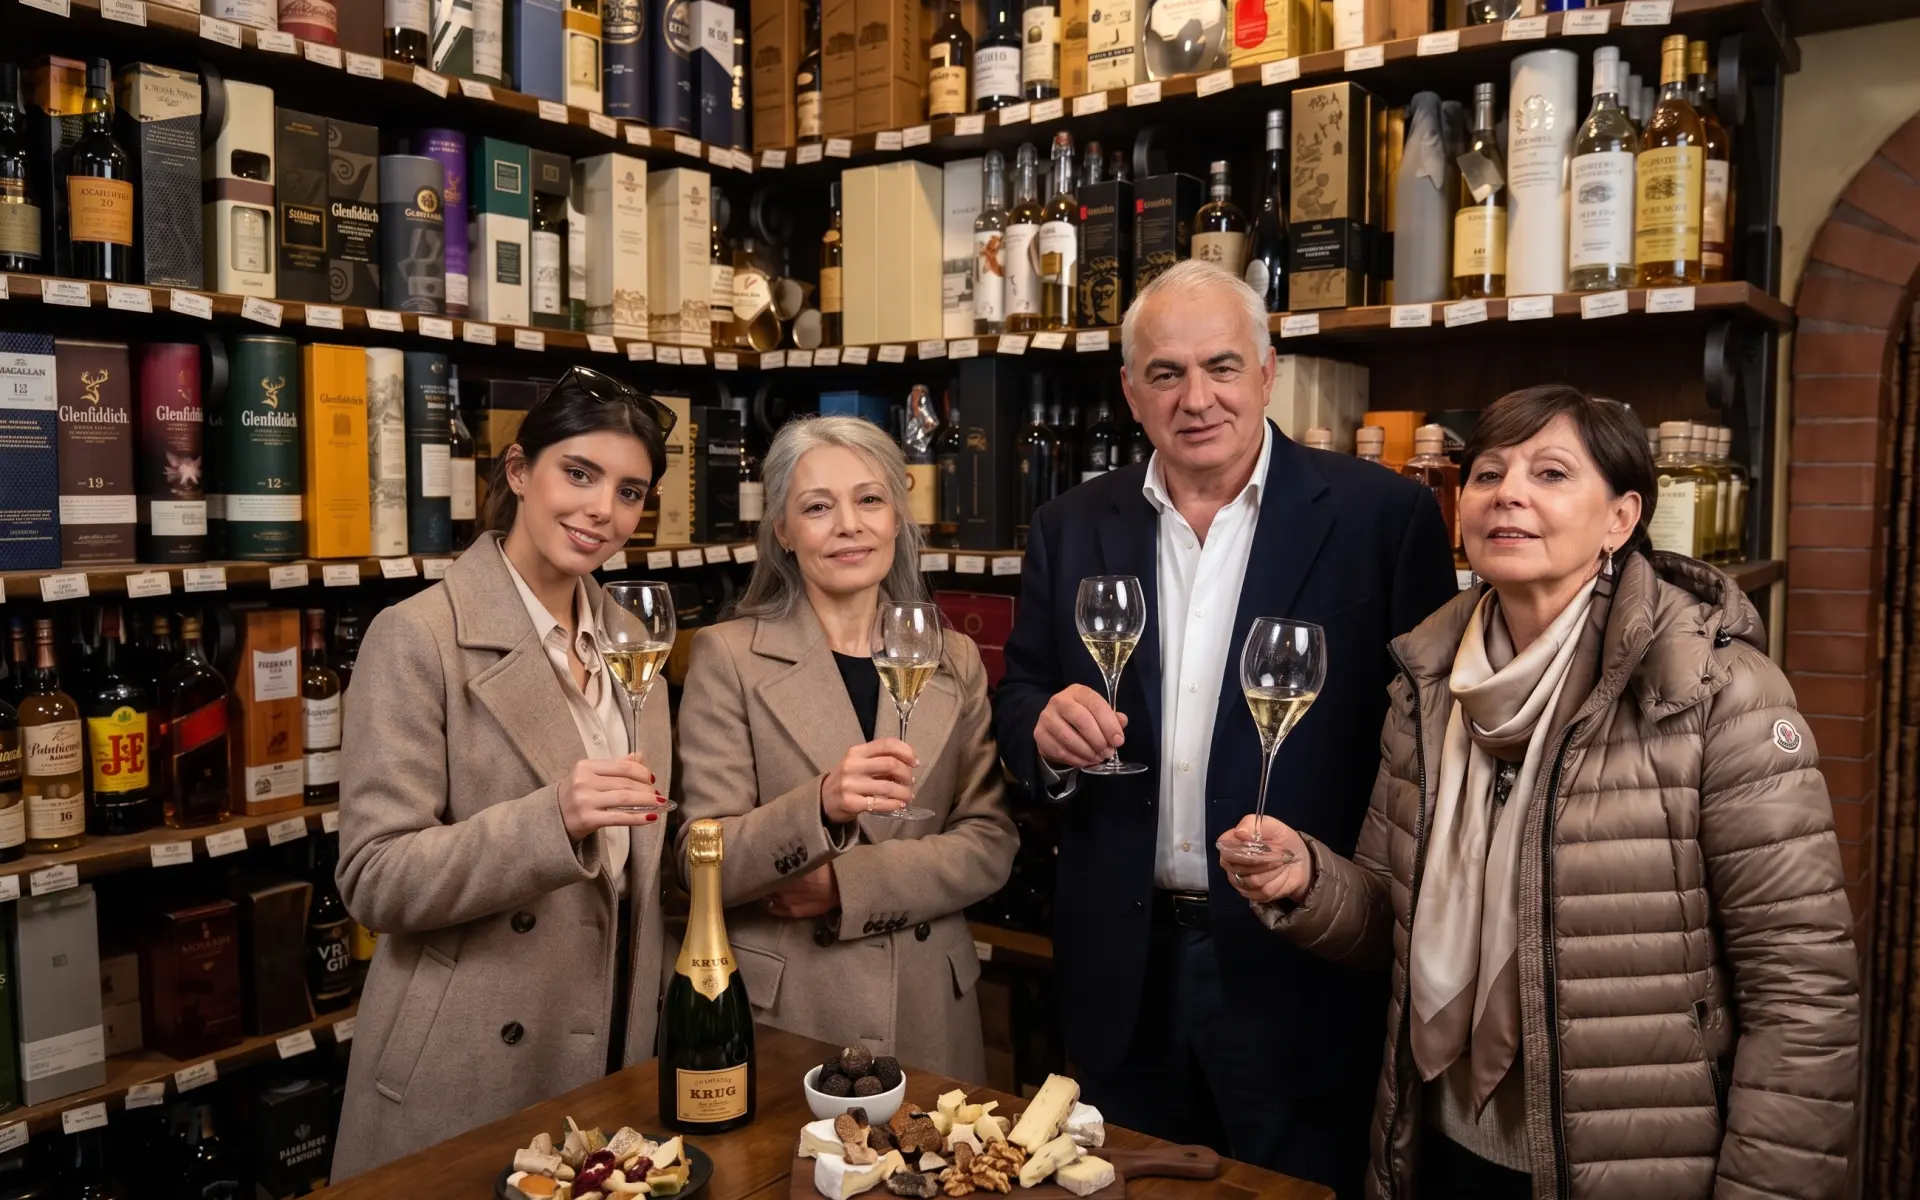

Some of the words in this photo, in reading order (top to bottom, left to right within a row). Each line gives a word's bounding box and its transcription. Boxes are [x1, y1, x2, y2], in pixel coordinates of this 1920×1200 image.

[331, 202, 379, 224] Glenfiddich
[59, 405, 130, 424] Glenfiddich
[241, 410, 298, 428] Glenfiddich
[267, 478, 282, 489] 12
[59, 810, 73, 822] 16
[691, 957, 729, 968] KRUG
[690, 1085, 737, 1099] KRUG
